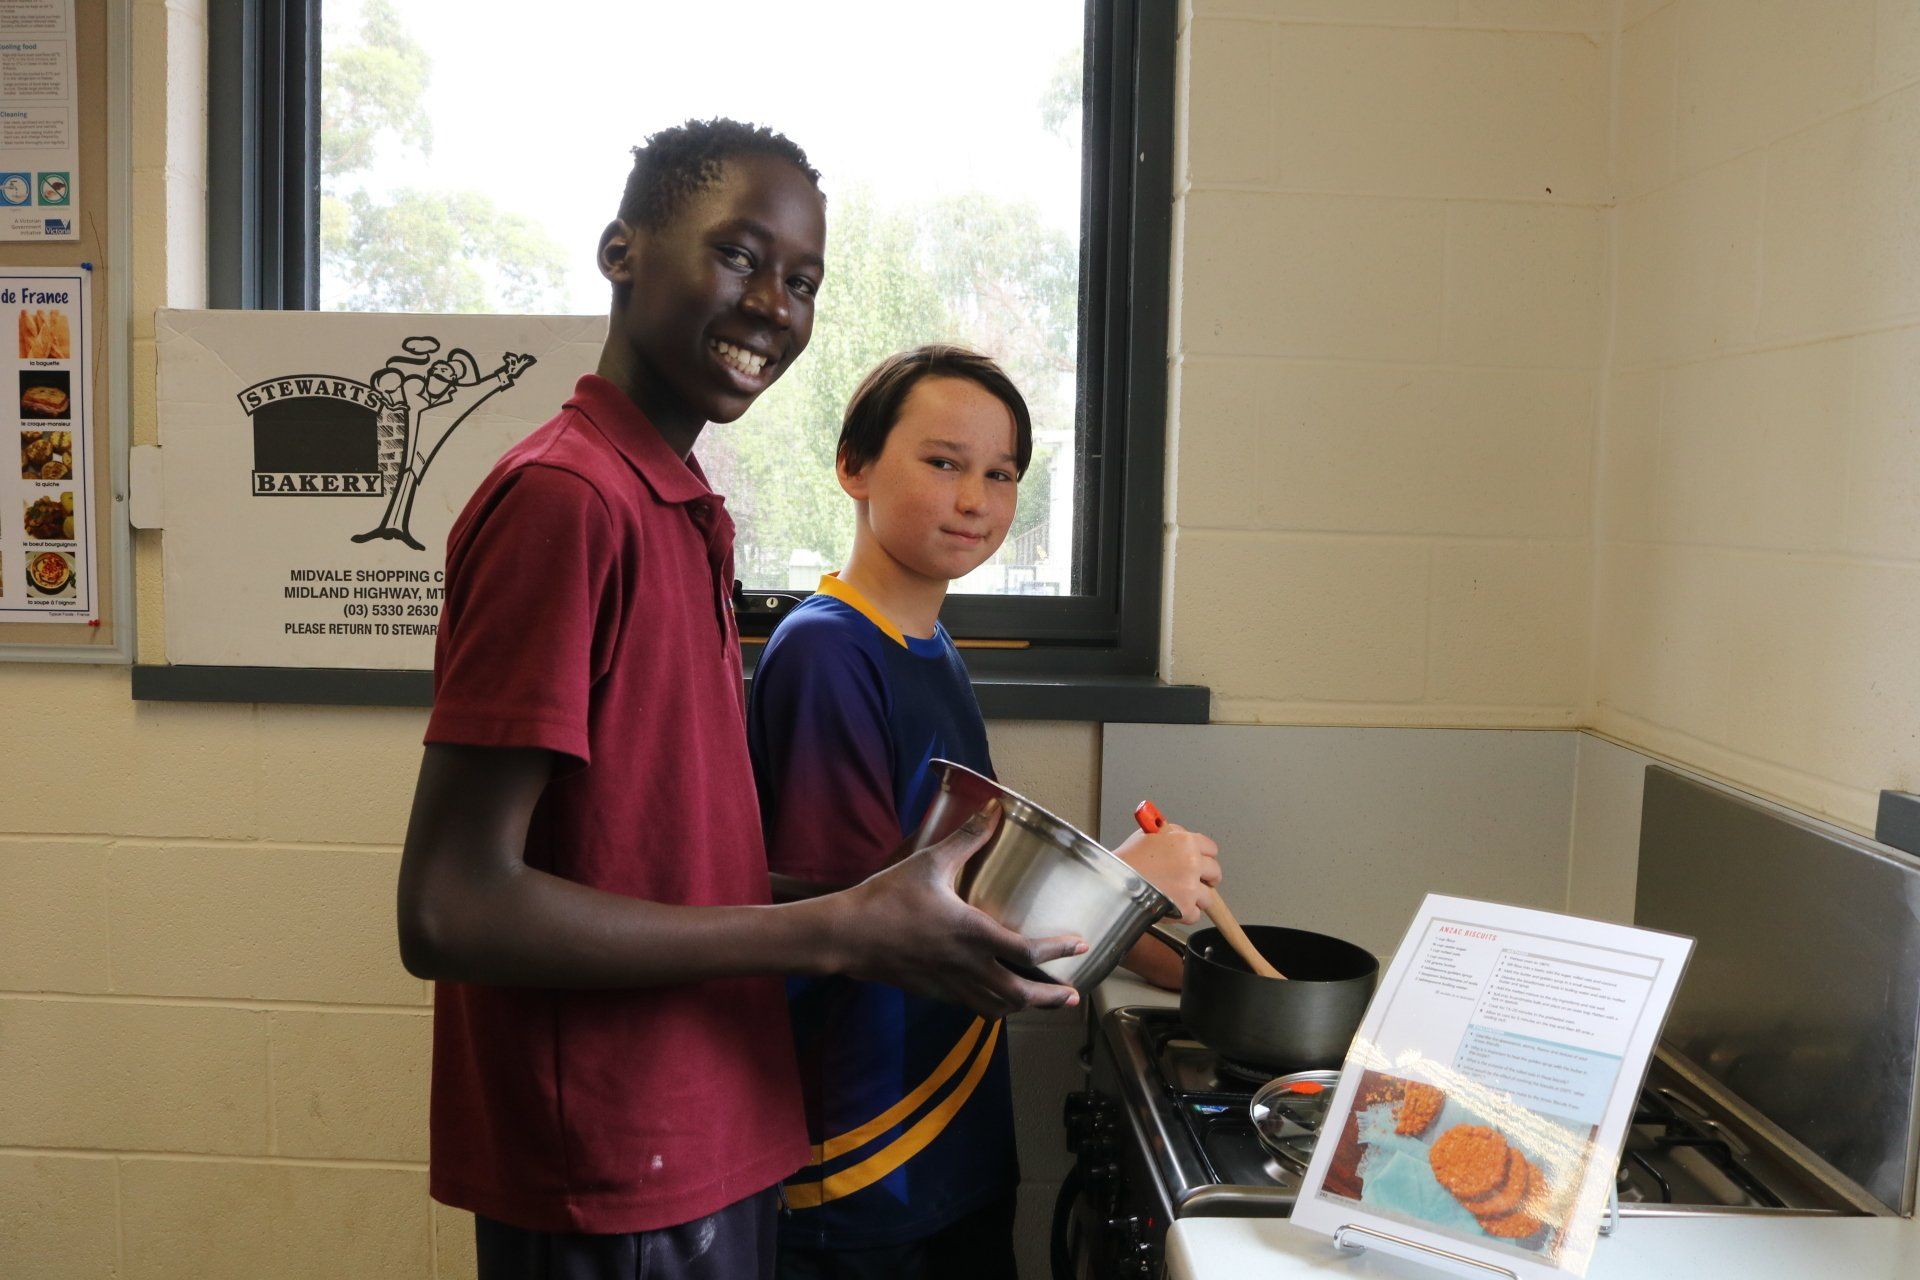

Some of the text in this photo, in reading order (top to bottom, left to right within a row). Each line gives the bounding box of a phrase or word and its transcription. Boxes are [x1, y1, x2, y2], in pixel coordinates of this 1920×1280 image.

[0, 111, 27, 119] Cleaning
[1, 288, 69, 304] de France
[36, 360, 60, 368] baguette
[246, 379, 380, 409] STEWARTS
[257, 474, 380, 492] BAKERY
[44, 541, 77, 549] bourguignon
[290, 569, 352, 582] MIDVALE
[356, 570, 430, 582] SHOPPING
[284, 586, 349, 599] MIDLAND
[353, 587, 422, 602] HIGHWAY,
[343, 603, 438, 618] (03) 5330 2630
[284, 623, 439, 636] PLEASE RETURN TO STEWAR
[1439, 926, 1463, 936] ANZAC
[1464, 930, 1498, 942] BISCUITS
